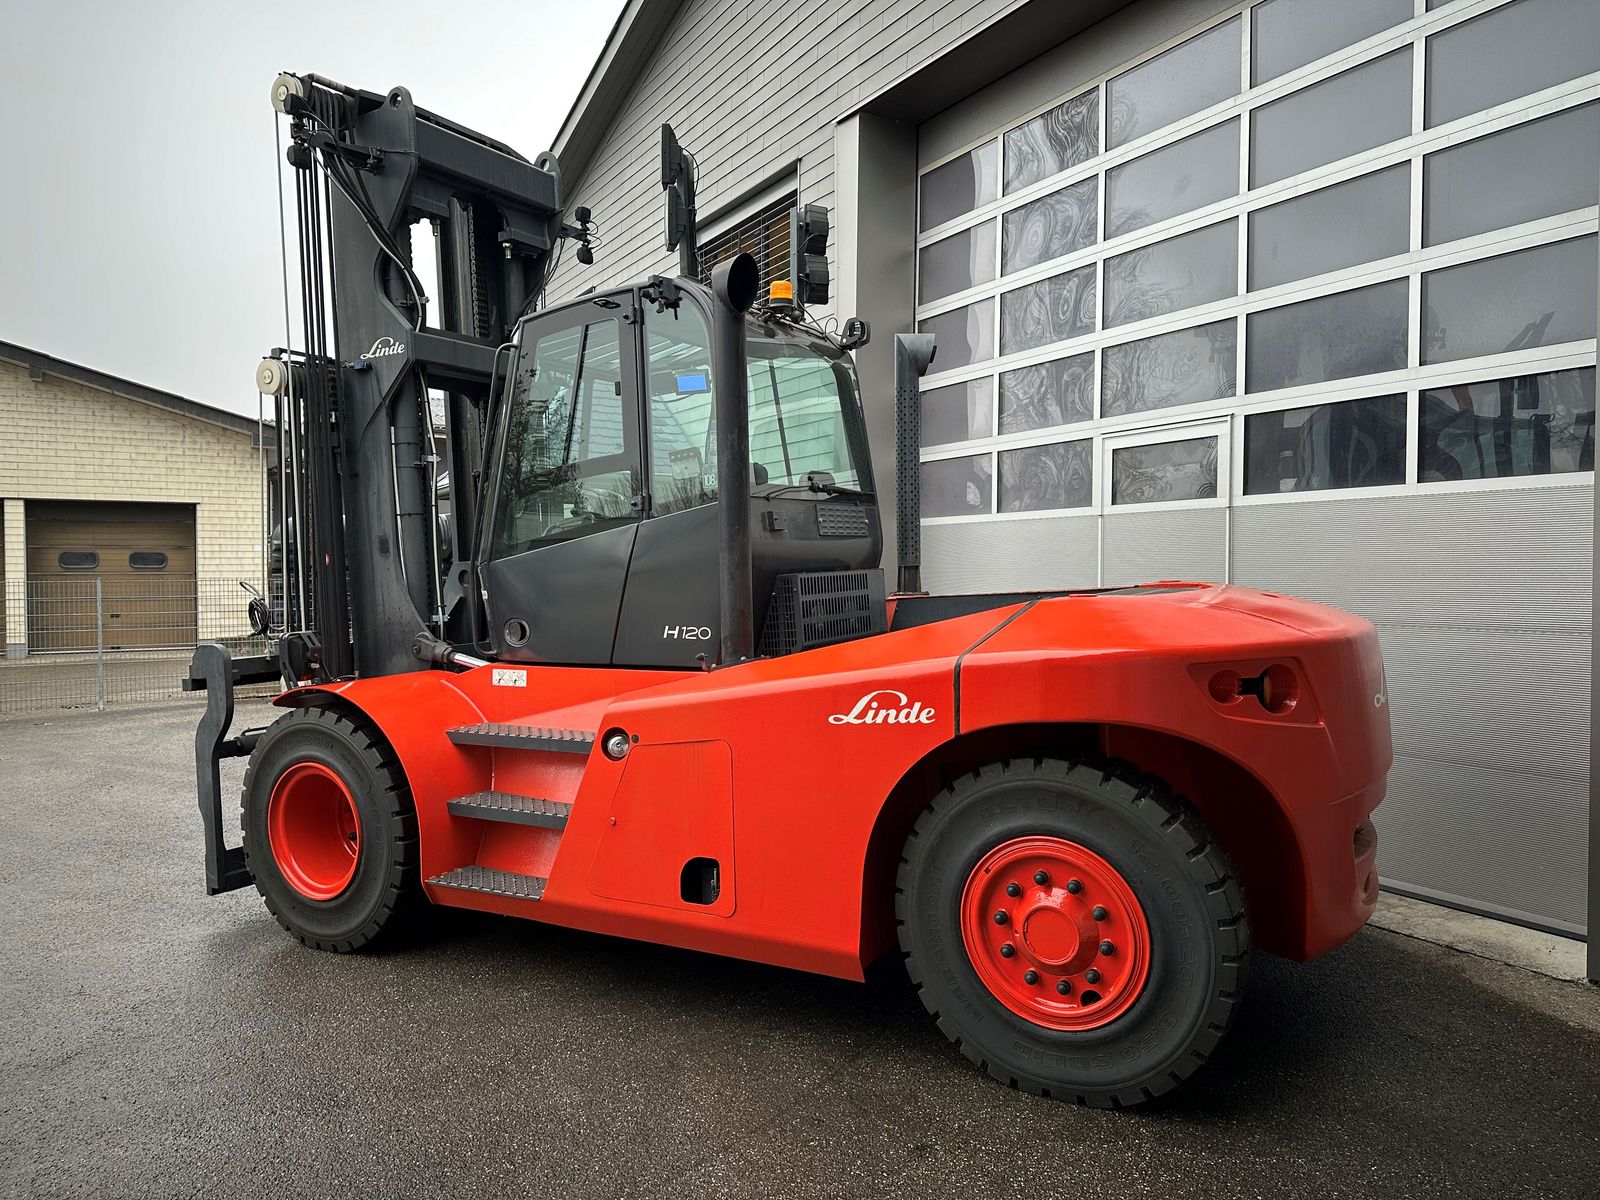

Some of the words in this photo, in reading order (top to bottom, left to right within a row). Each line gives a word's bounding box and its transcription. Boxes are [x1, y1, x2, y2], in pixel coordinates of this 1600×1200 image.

[360, 336, 405, 360] Linde
[663, 625, 712, 640] H120
[828, 689, 936, 725] Linde
